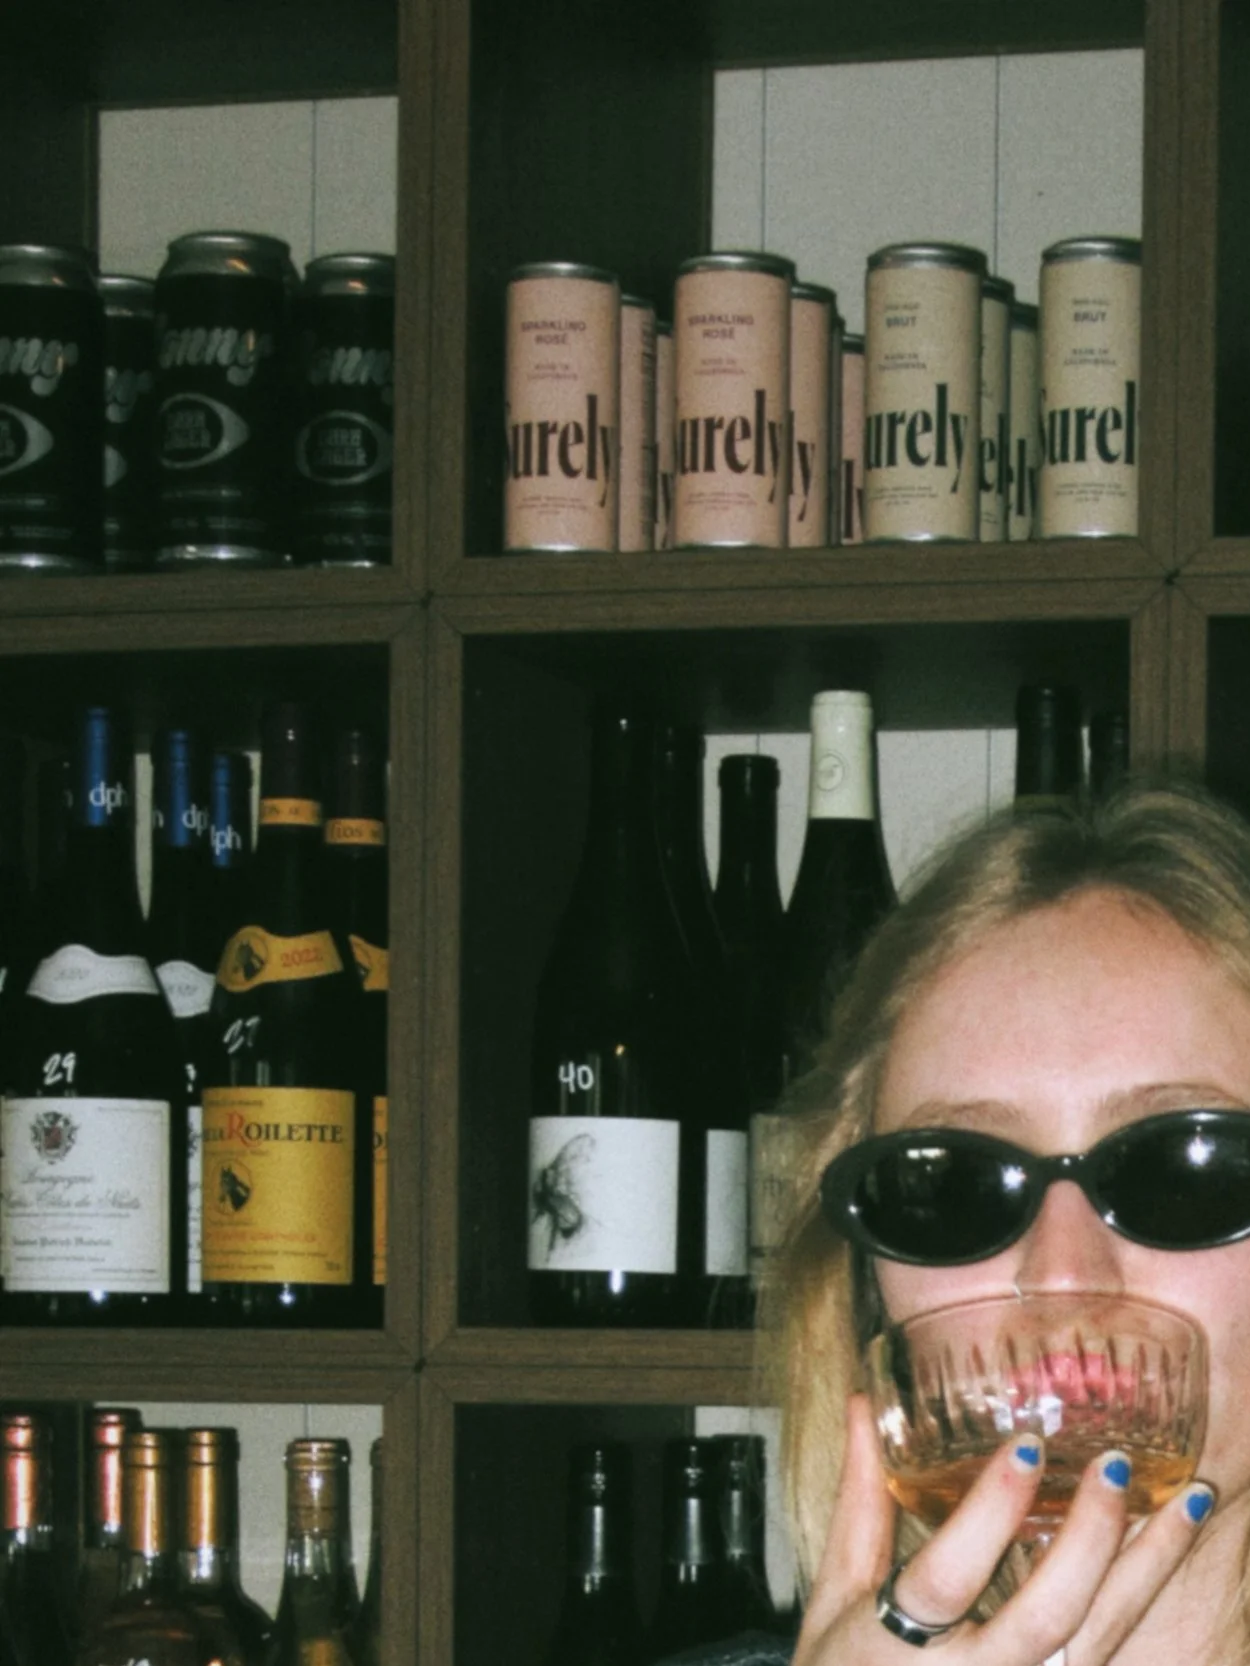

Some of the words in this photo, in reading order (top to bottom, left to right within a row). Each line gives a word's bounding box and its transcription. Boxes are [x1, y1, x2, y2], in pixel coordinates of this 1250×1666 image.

[43, 1052, 76, 1085] 29
[559, 1062, 595, 1093] 40
[223, 1110, 344, 1148] ROILETTE
